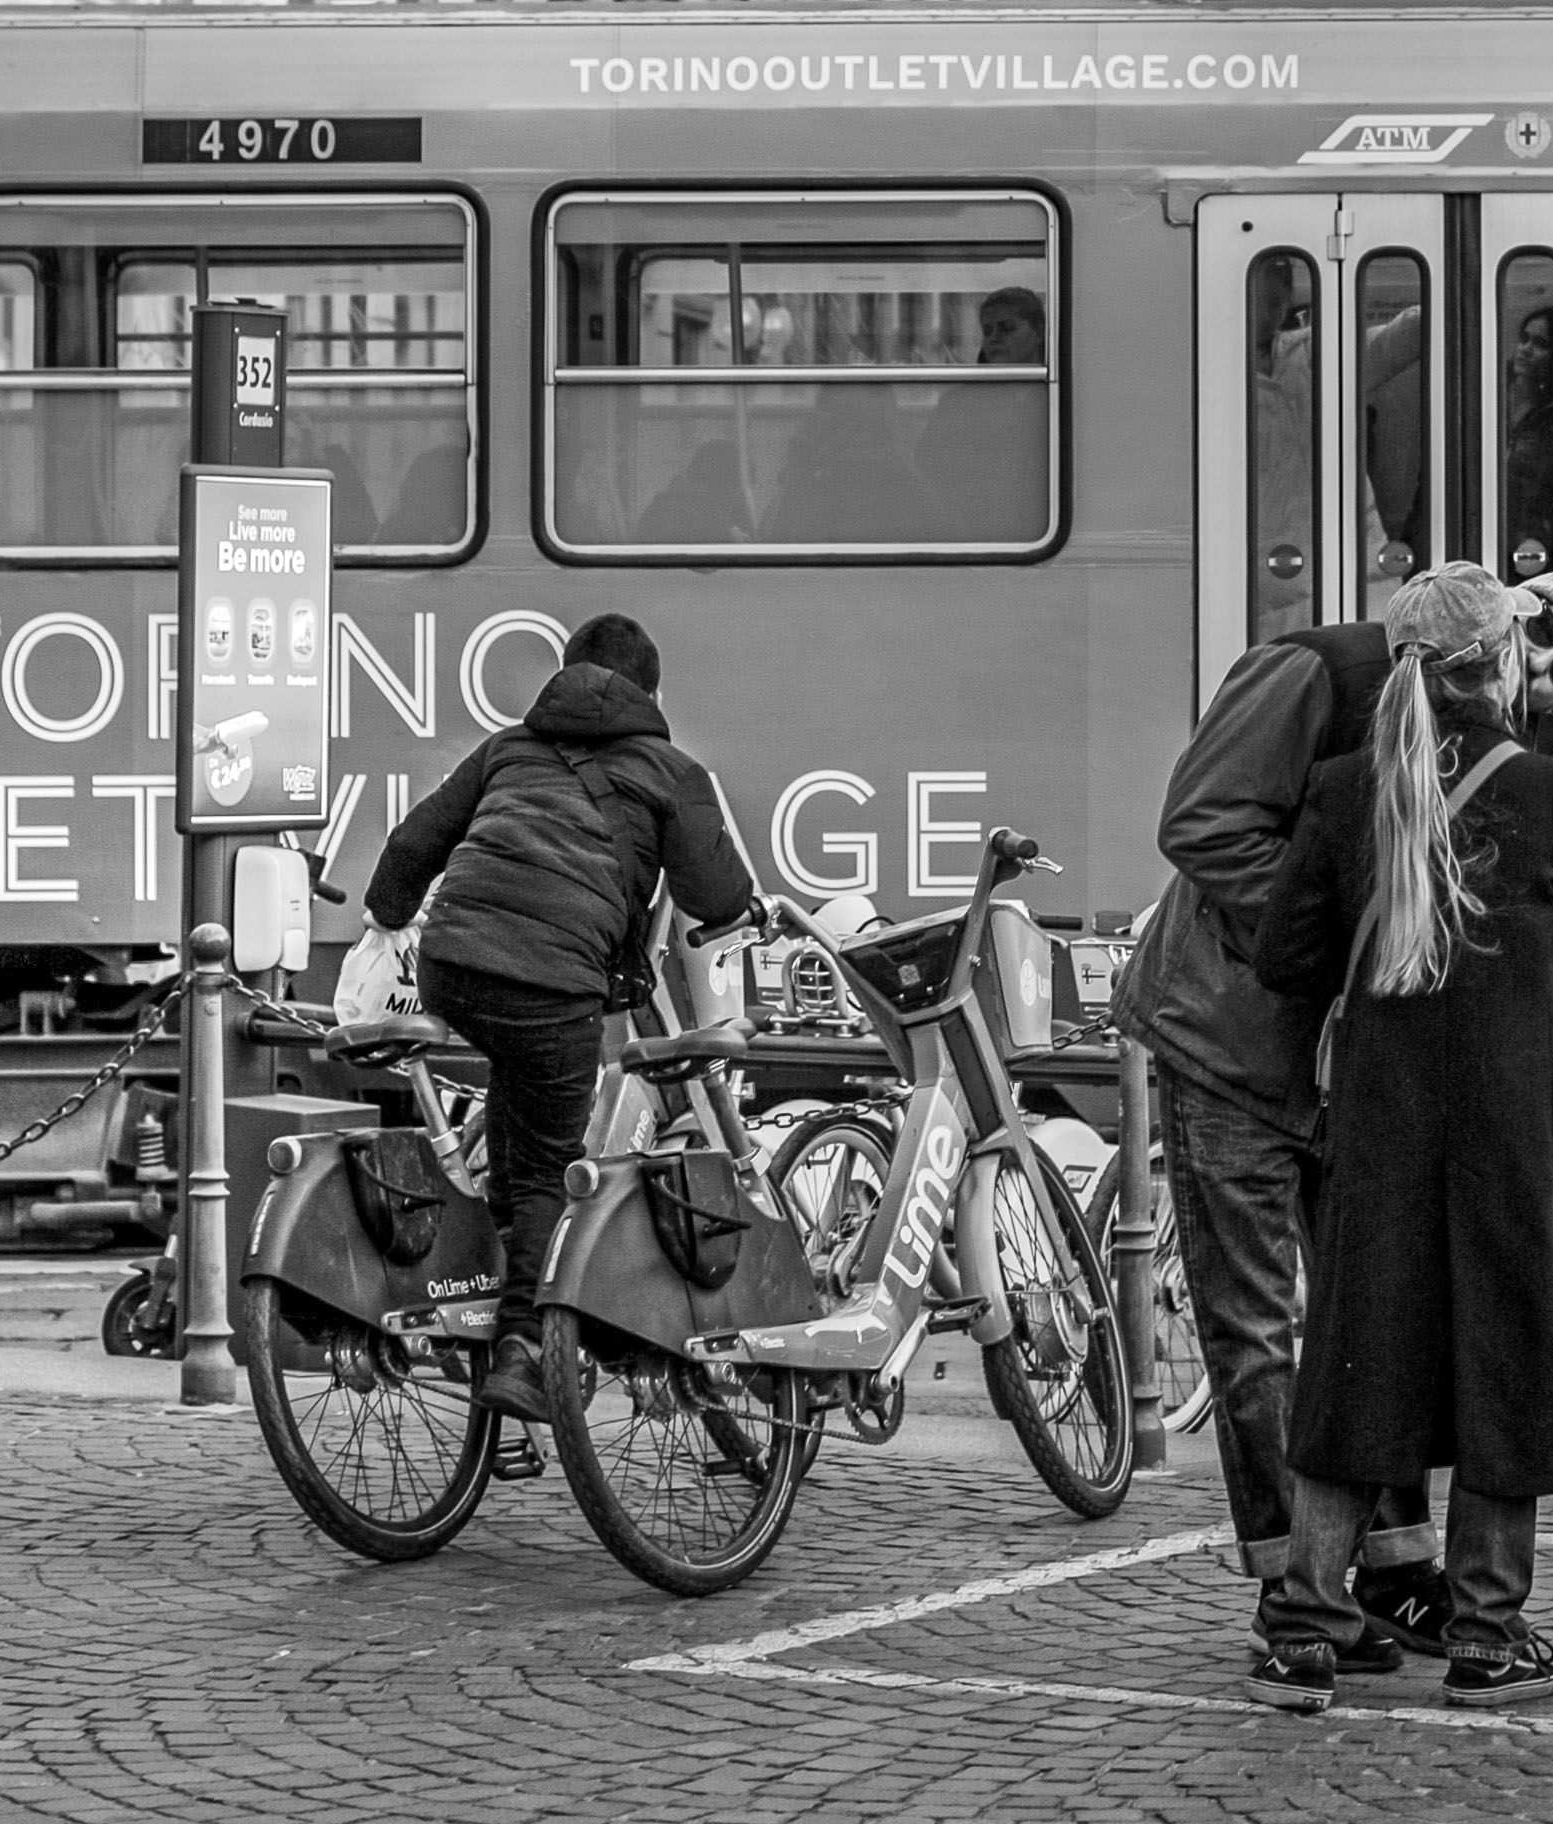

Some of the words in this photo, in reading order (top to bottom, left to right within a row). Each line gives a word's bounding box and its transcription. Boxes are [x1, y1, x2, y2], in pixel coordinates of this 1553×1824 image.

[570, 53, 1300, 93] TORINOOUTLETVILLAGE.COM
[198, 119, 336, 160] 4970
[1355, 126, 1432, 151] ATM
[237, 355, 272, 389] 352
[238, 504, 258, 522] See
[259, 507, 288, 522] more
[228, 520, 258, 542] Live
[260, 524, 296, 544] more
[218, 540, 247, 572] Be
[249, 547, 306, 575] more
[884, 1125, 962, 1290] Lime
[427, 1280, 445, 1299] On
[445, 1277, 470, 1297] Lime
